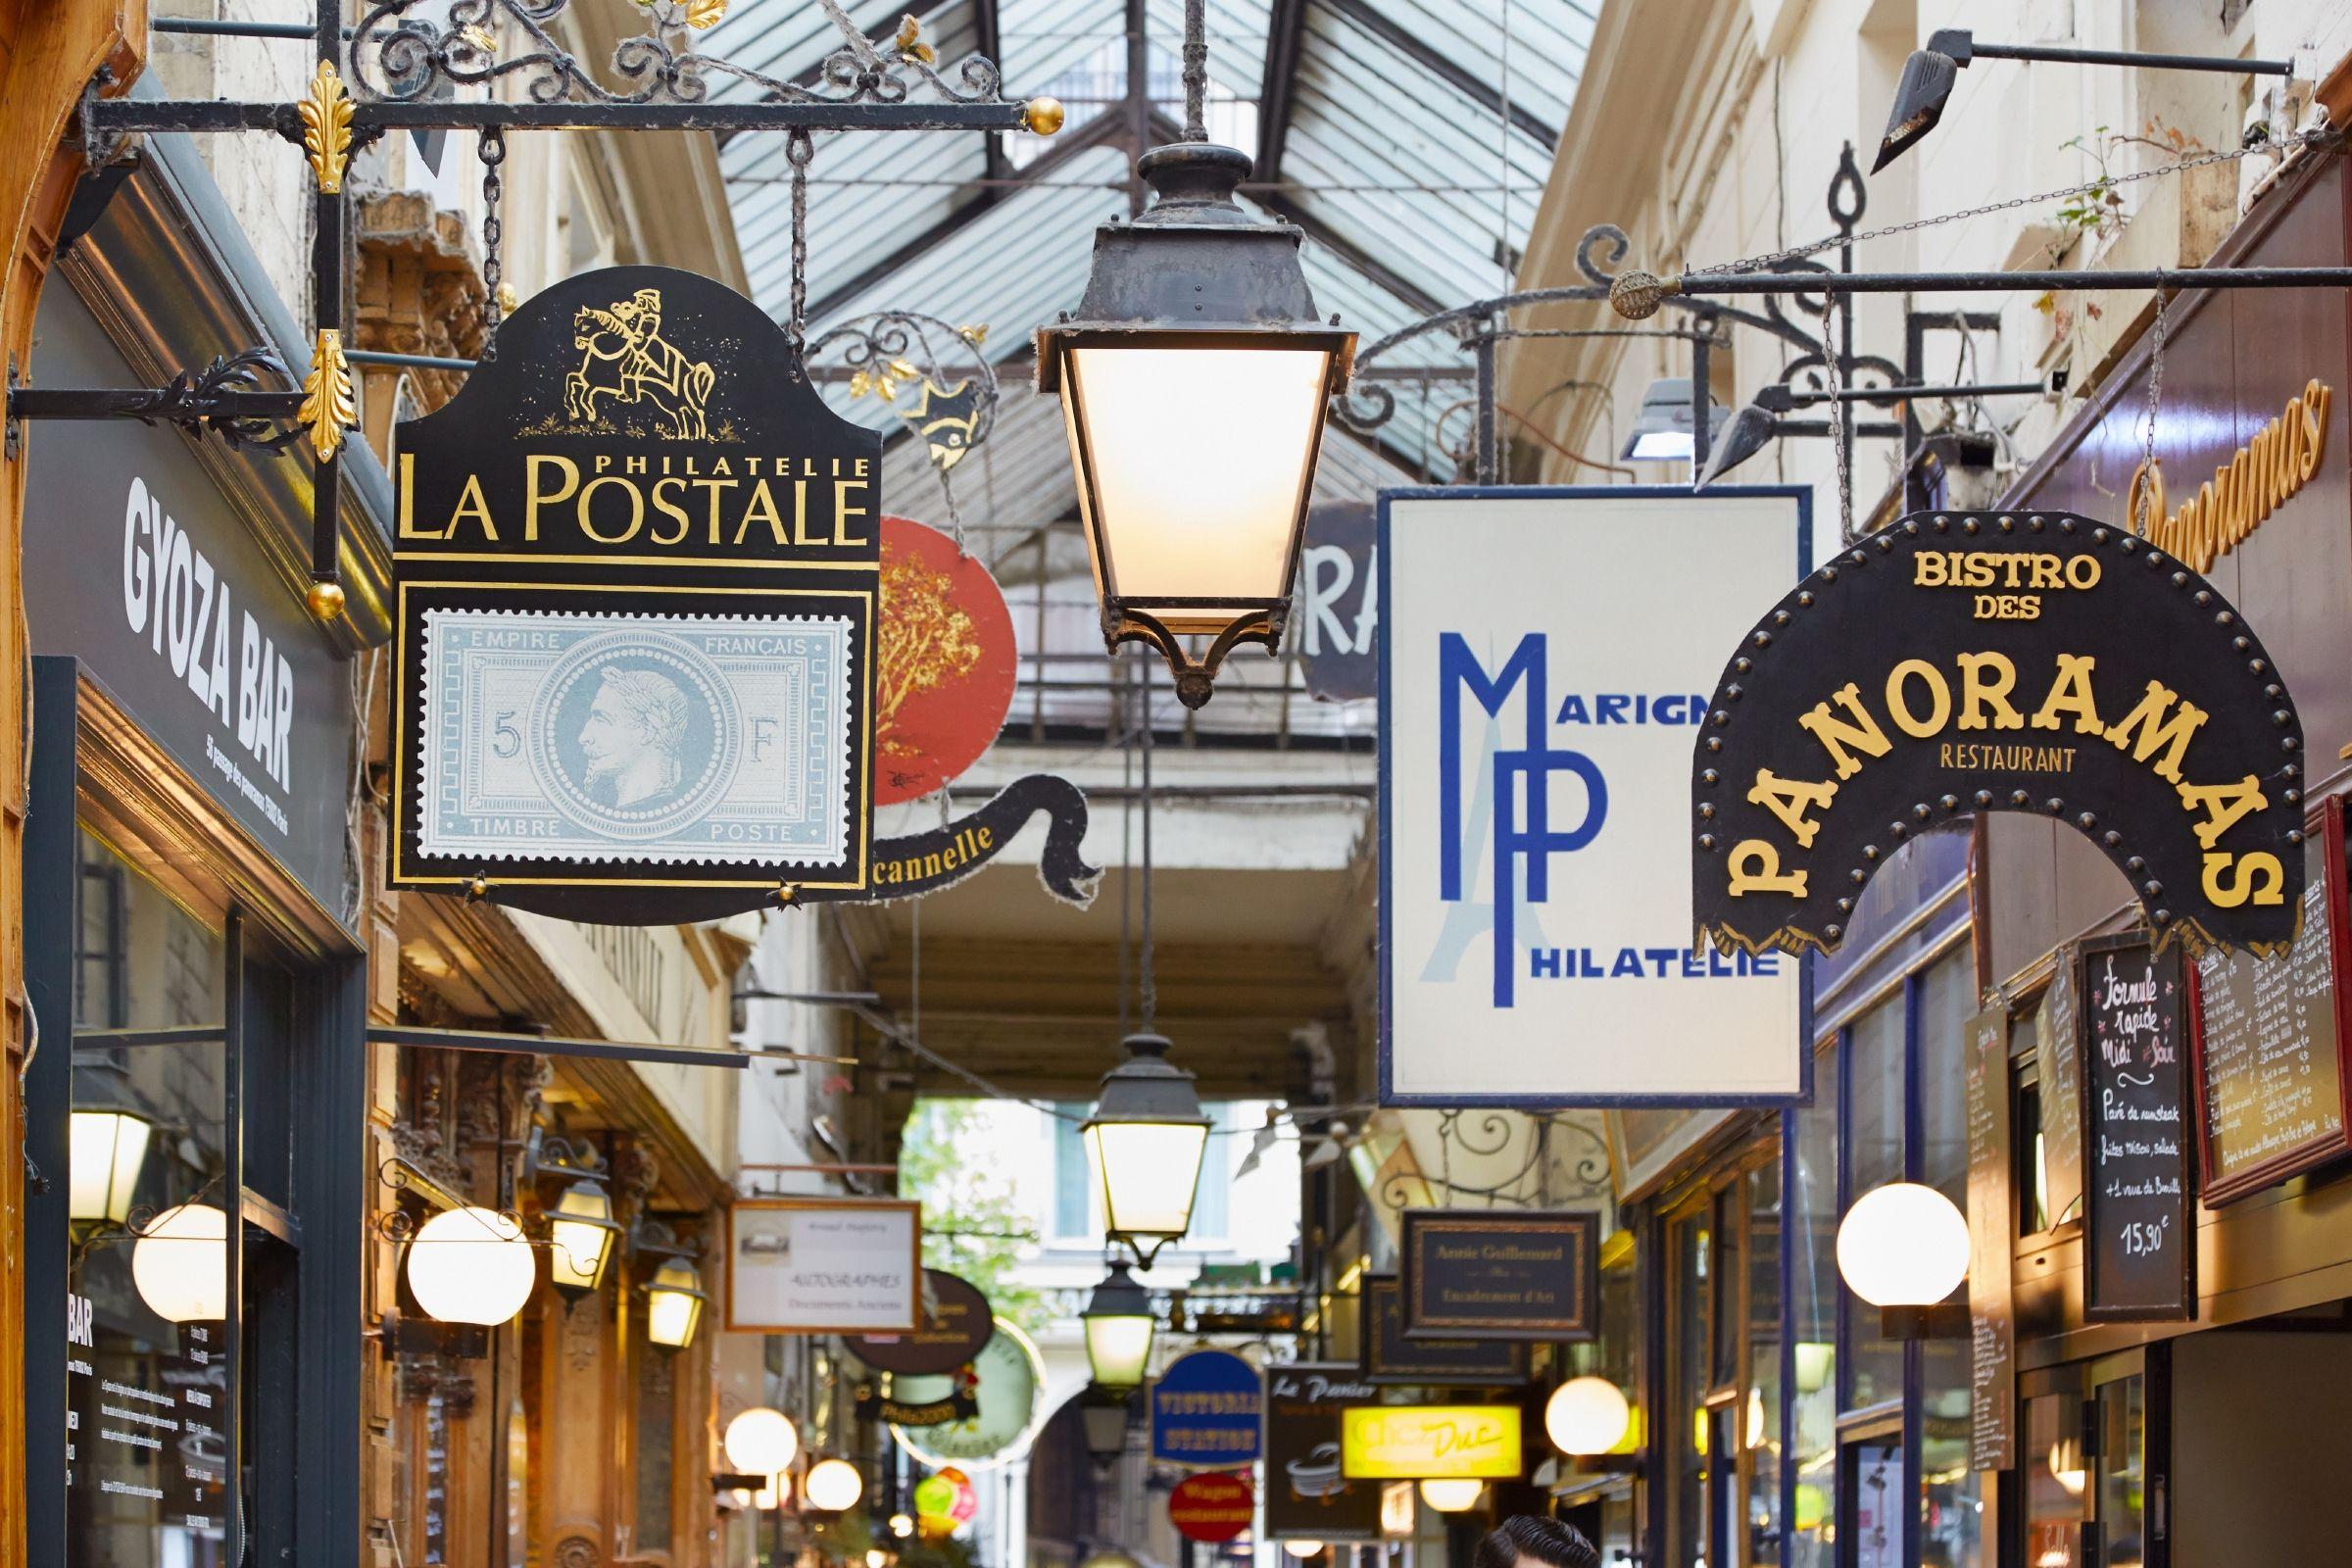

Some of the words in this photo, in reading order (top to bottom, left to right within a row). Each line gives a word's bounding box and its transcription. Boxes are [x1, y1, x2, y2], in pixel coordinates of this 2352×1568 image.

[595, 456, 868, 476] PHILATELIE
[399, 453, 498, 541] LA
[525, 454, 868, 547] POSTALE
[1913, 550, 2101, 590] BISTRO
[1974, 595, 2040, 621] DES
[123, 476, 230, 728] GYOZA
[239, 609, 293, 795] BAR
[471, 630, 561, 649] EMPIRE
[705, 638, 807, 658] FRANÇAIS
[493, 711, 521, 759] 5
[749, 716, 779, 762] F
[1939, 743, 2077, 773] RESTAURANT
[1727, 651, 2284, 909] PANORAMAS
[470, 819, 561, 837] TIMBRE
[710, 824, 792, 842] POSTE
[872, 826, 995, 885] cannelle
[2128, 1105, 2140, 1121] de
[68, 1294, 93, 1348] BAR
[1271, 1375, 1300, 1397] Le
